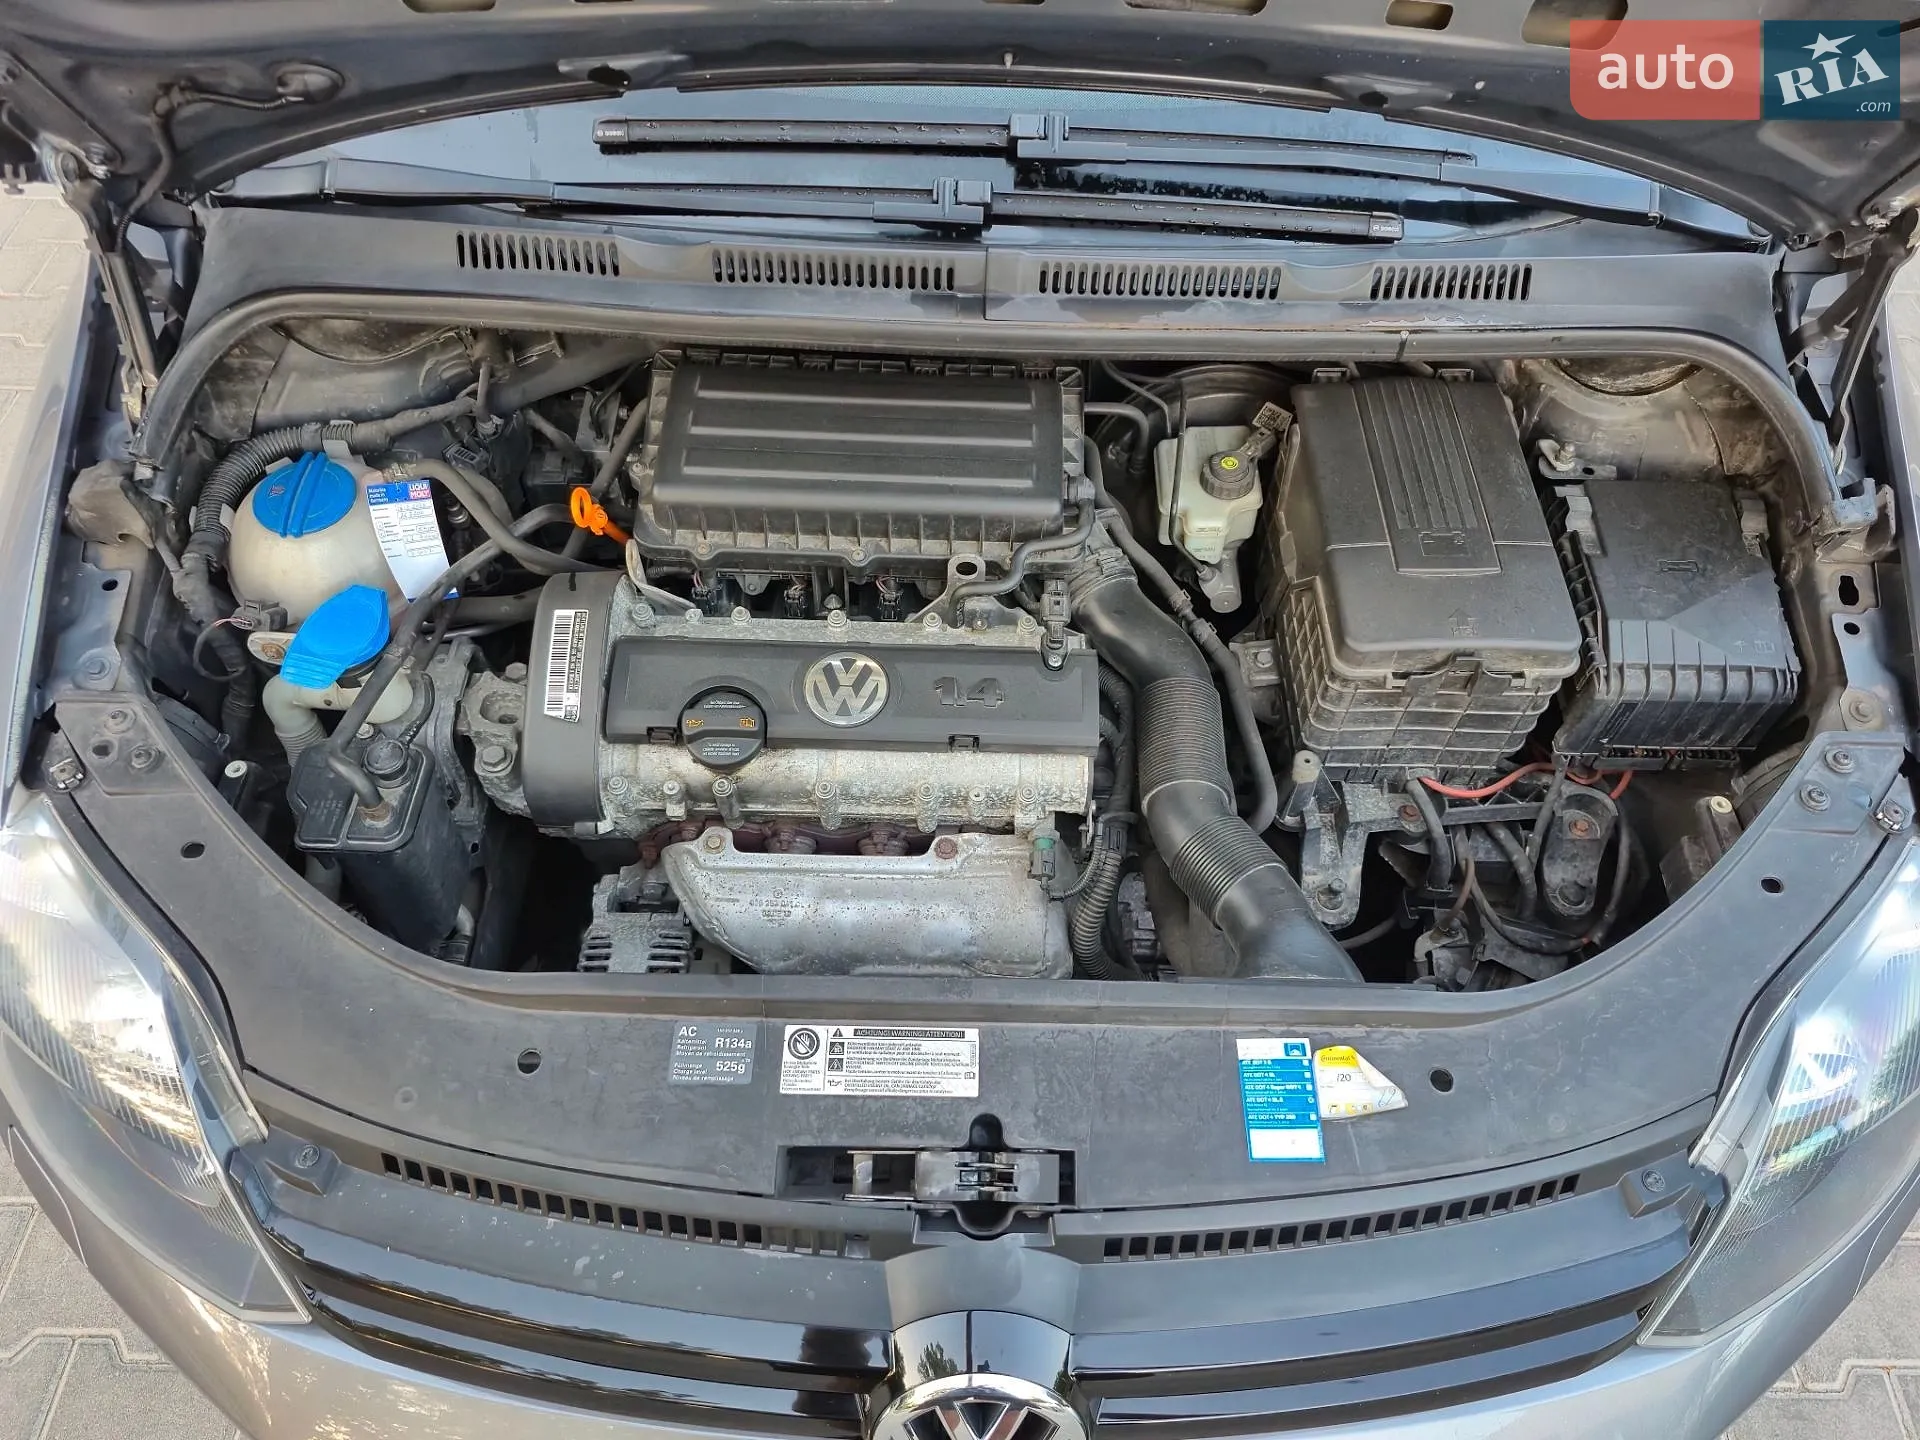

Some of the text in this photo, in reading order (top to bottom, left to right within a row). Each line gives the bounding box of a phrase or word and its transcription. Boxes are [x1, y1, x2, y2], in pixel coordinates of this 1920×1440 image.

[410, 489, 430, 499] MOLY
[804, 651, 890, 728] VW
[678, 1026, 697, 1037] AC
[715, 1037, 752, 1049] R134a
[716, 1060, 746, 1074] 525g
